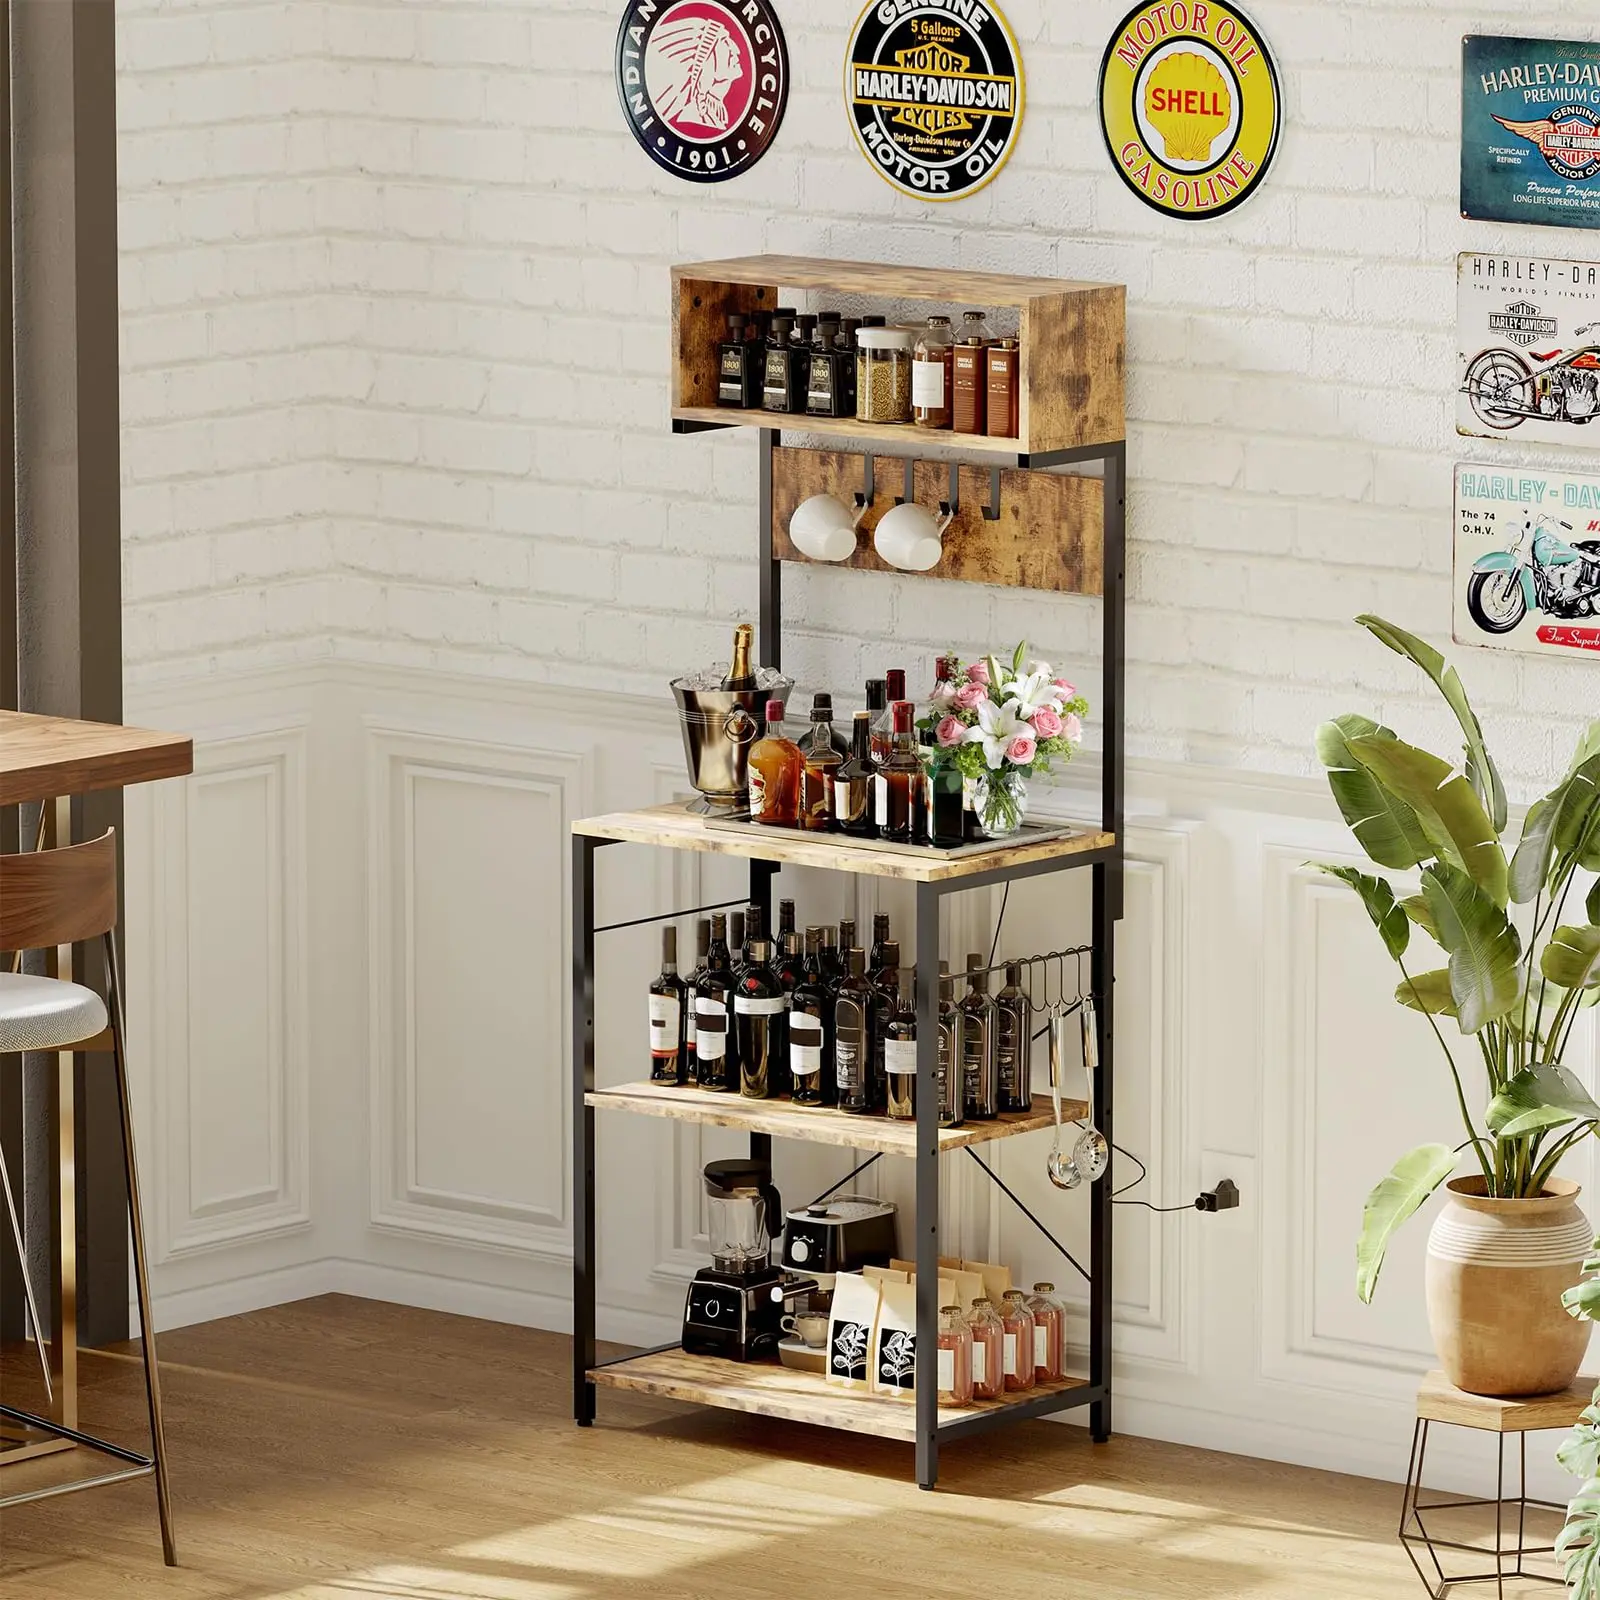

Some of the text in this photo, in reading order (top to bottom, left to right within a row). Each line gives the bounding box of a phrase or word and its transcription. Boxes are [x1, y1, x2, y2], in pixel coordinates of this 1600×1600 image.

[911, 19, 961, 37] 5 Gallons
[1117, 2, 1257, 76] MOTOR OIL
[625, 2, 657, 131] INDIAN
[903, 46, 963, 73] MOTOR
[856, 70, 1010, 110] HARLEY-DAVIDSON
[1523, 87, 1587, 104] PREMIUM
[1151, 88, 1224, 117] SHELL
[903, 107, 962, 131] CYCLES
[1552, 106, 1600, 124] GENUINE
[1560, 122, 1590, 135] MOTOR
[675, 146, 731, 169] 1901
[862, 121, 1004, 191] MOTOR OIL
[1488, 146, 1530, 156] SPECIFICALLY
[1560, 151, 1590, 165] CYCLES
[1121, 142, 1255, 208] GASOLINE
[1549, 159, 1584, 178] MOTOR
[1527, 181, 1561, 195] Proven
[1513, 194, 1600, 209] LONG LIFE SUPERIOR WEAR
[1509, 303, 1536, 315] MOTOR
[1490, 315, 1555, 332] HARLEY-DAVIDSON
[1509, 333, 1536, 344] CYCLES
[724, 360, 739, 369] 1800
[768, 365, 784, 373] 1800
[813, 369, 828, 377] 1800
[1461, 509, 1495, 520] The 74
[1462, 524, 1495, 535] O.H.V.
[1546, 627, 1600, 648] For Superb
